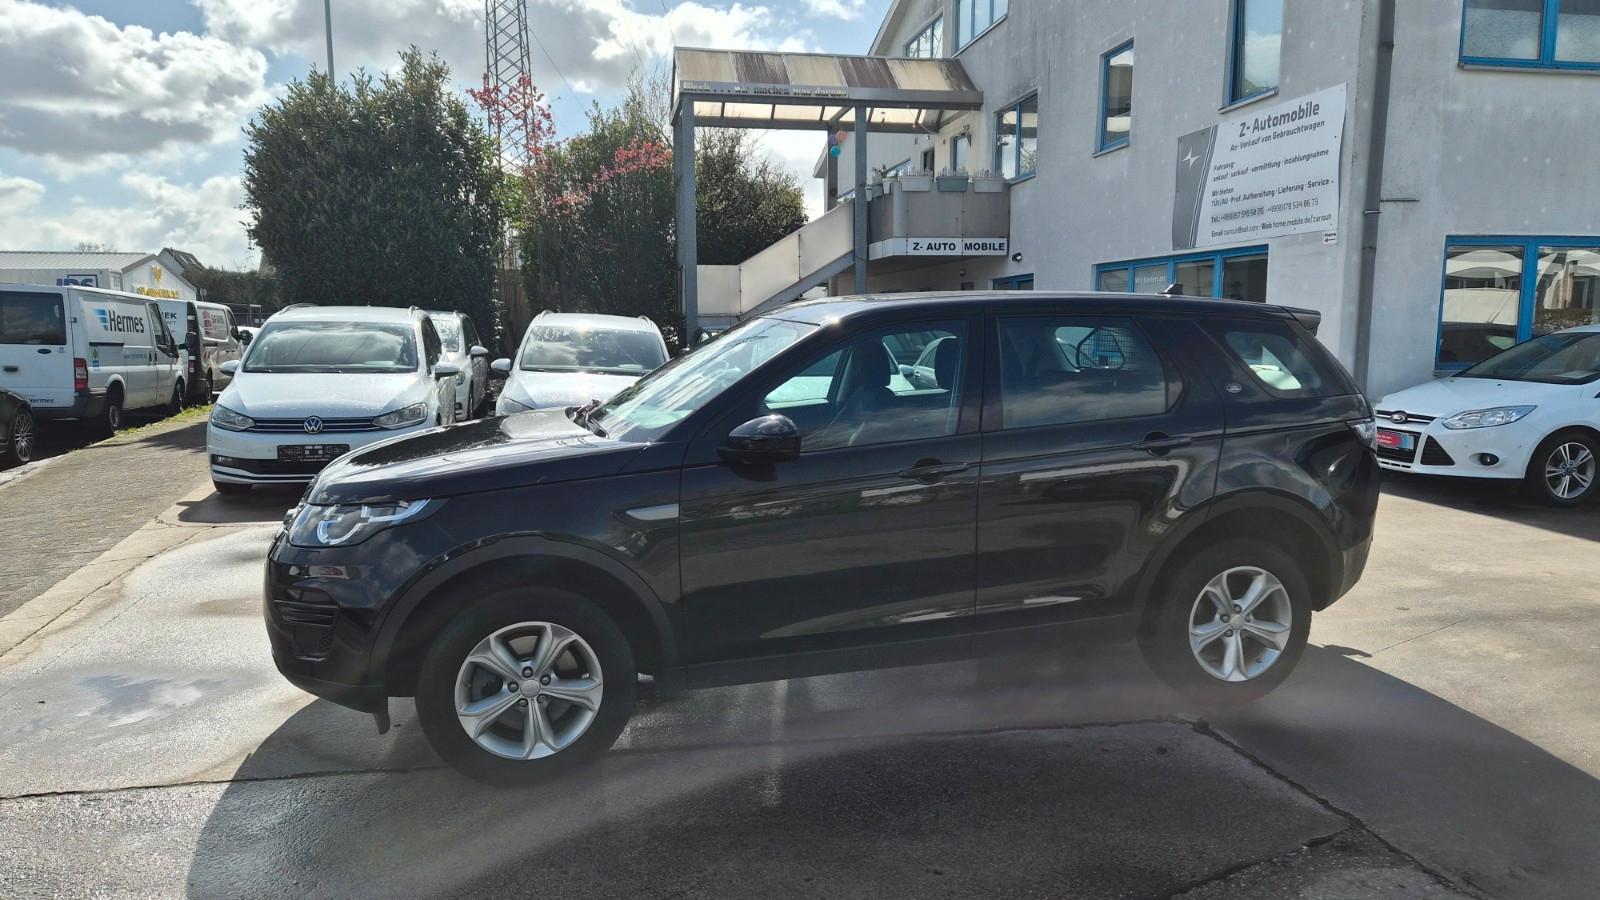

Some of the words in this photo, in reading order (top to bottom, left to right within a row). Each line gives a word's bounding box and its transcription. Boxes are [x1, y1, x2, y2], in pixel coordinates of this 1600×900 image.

[753, 85, 790, 95] machen
[1252, 101, 1320, 134] Automobile
[1261, 134, 1272, 144] von
[1272, 120, 1325, 140] Gebrauchtwagen
[1307, 178, 1330, 189] Service
[912, 242, 923, 251] Z-
[926, 242, 956, 251] AUTO
[964, 242, 1005, 251] MOBILE
[108, 310, 145, 333] Hermes
